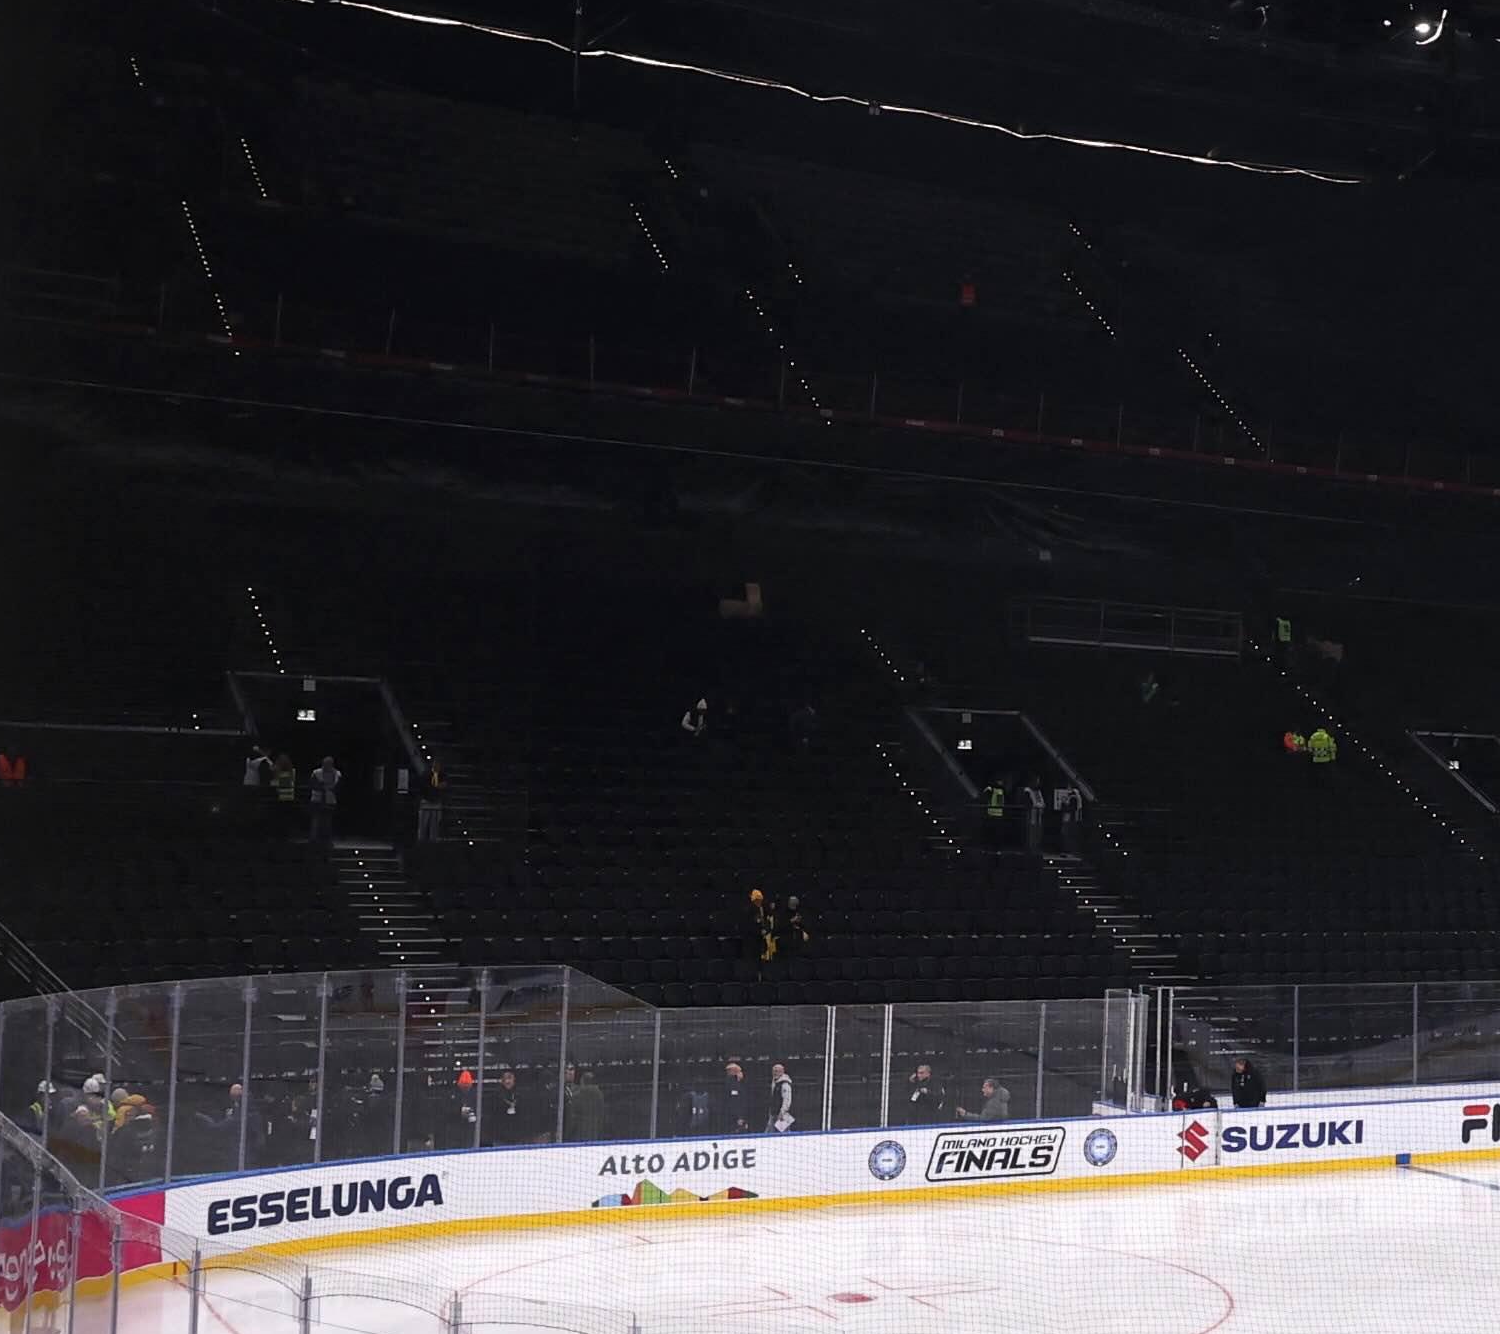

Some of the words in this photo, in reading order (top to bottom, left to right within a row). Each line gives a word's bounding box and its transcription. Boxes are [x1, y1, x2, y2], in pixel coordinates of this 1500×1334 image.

[941, 1137, 997, 1150] MILANO
[1000, 1134, 1058, 1146] HOCKEY
[1221, 1119, 1364, 1153] SUZUKI
[934, 1145, 1054, 1174] FINALS
[207, 1173, 444, 1236] ESSELUNGA
